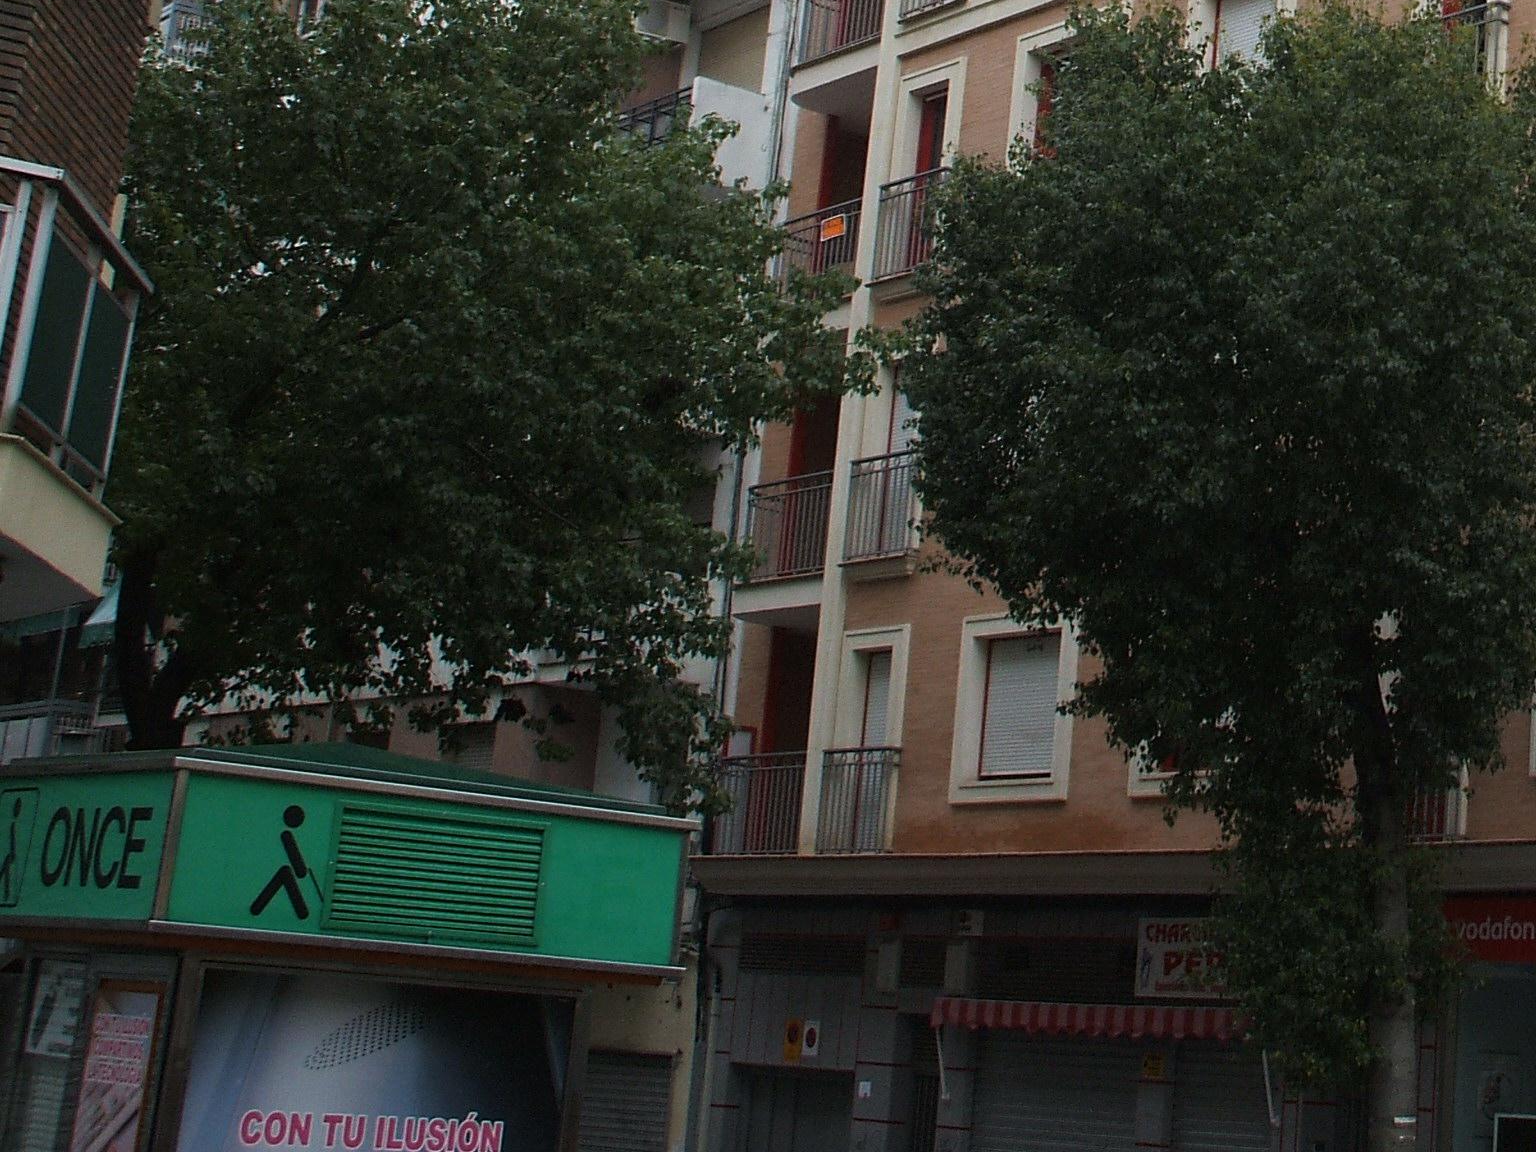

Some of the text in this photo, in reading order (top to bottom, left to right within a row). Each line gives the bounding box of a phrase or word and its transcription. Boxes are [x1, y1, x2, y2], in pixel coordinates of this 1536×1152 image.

[41, 806, 154, 889] ONCE
[240, 1109, 504, 1152] CON TU ILUSIÓN
